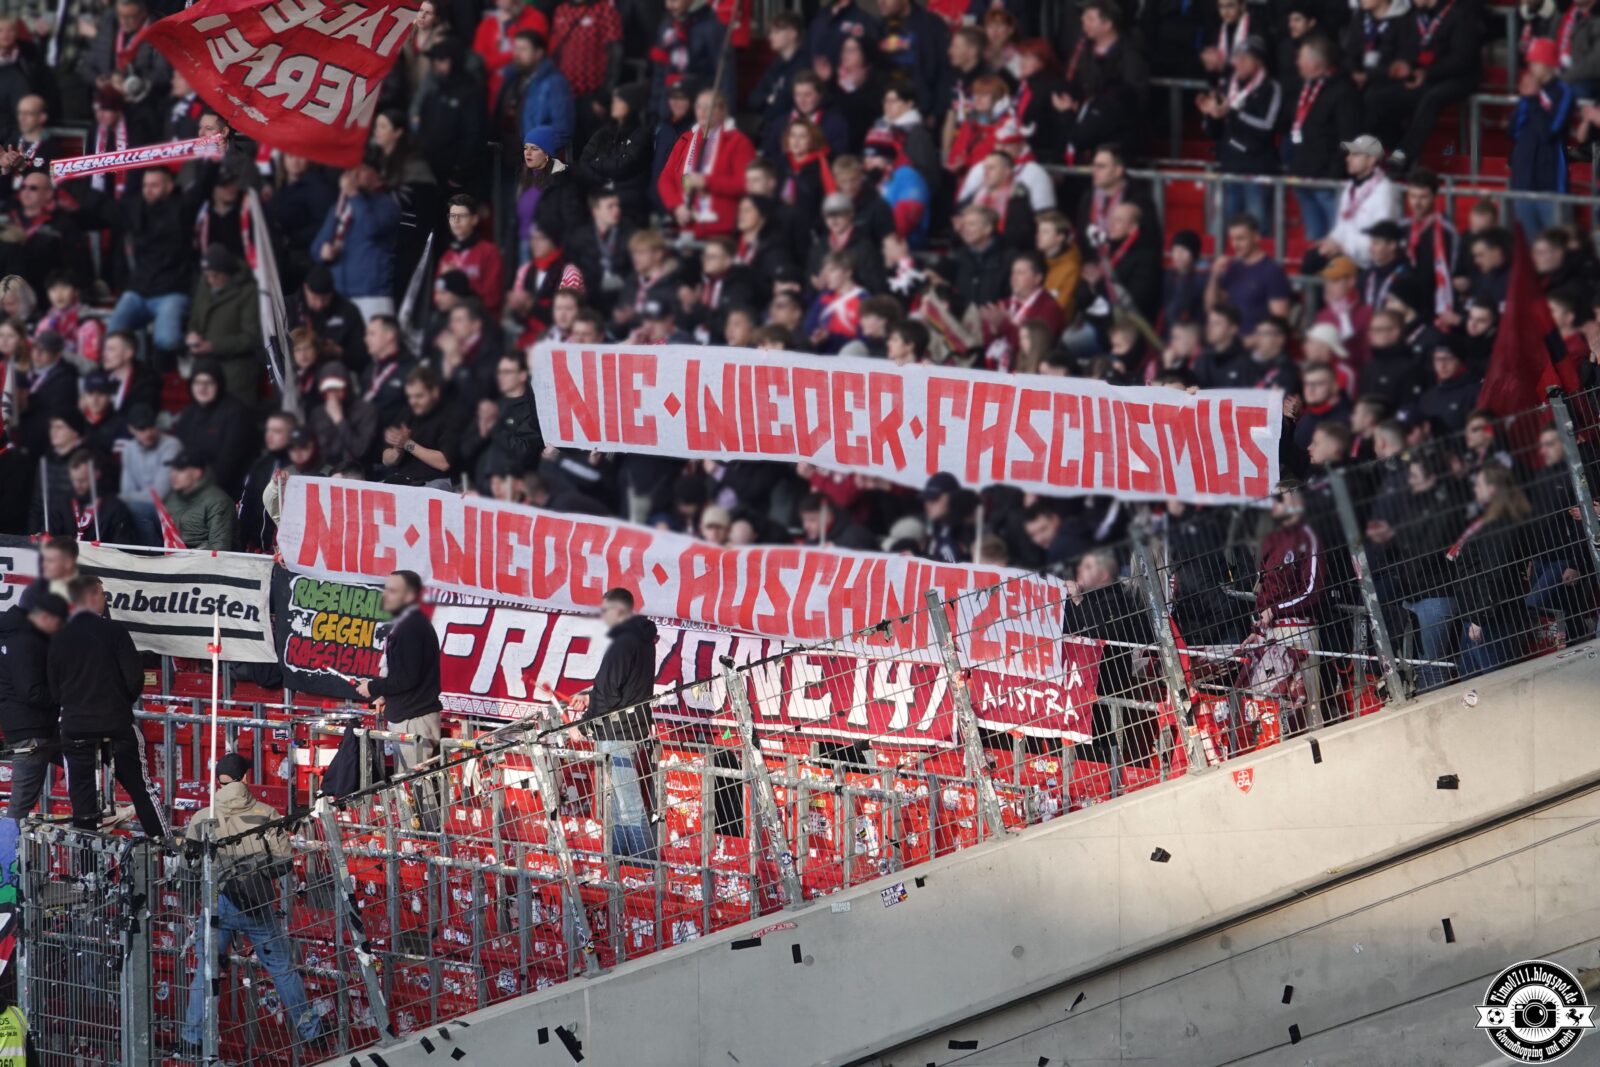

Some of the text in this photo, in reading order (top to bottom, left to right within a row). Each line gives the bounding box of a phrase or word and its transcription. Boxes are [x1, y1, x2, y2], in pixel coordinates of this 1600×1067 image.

[552, 351, 1270, 497] NIE WIEDER FASCHISMUS
[298, 483, 1000, 662] NIE WIEDER AUSCHWITZ
[103, 587, 260, 622] enballisten
[293, 577, 394, 621] RASENBAL
[312, 612, 374, 648] GEGEN
[287, 636, 384, 677] RASSISMU
